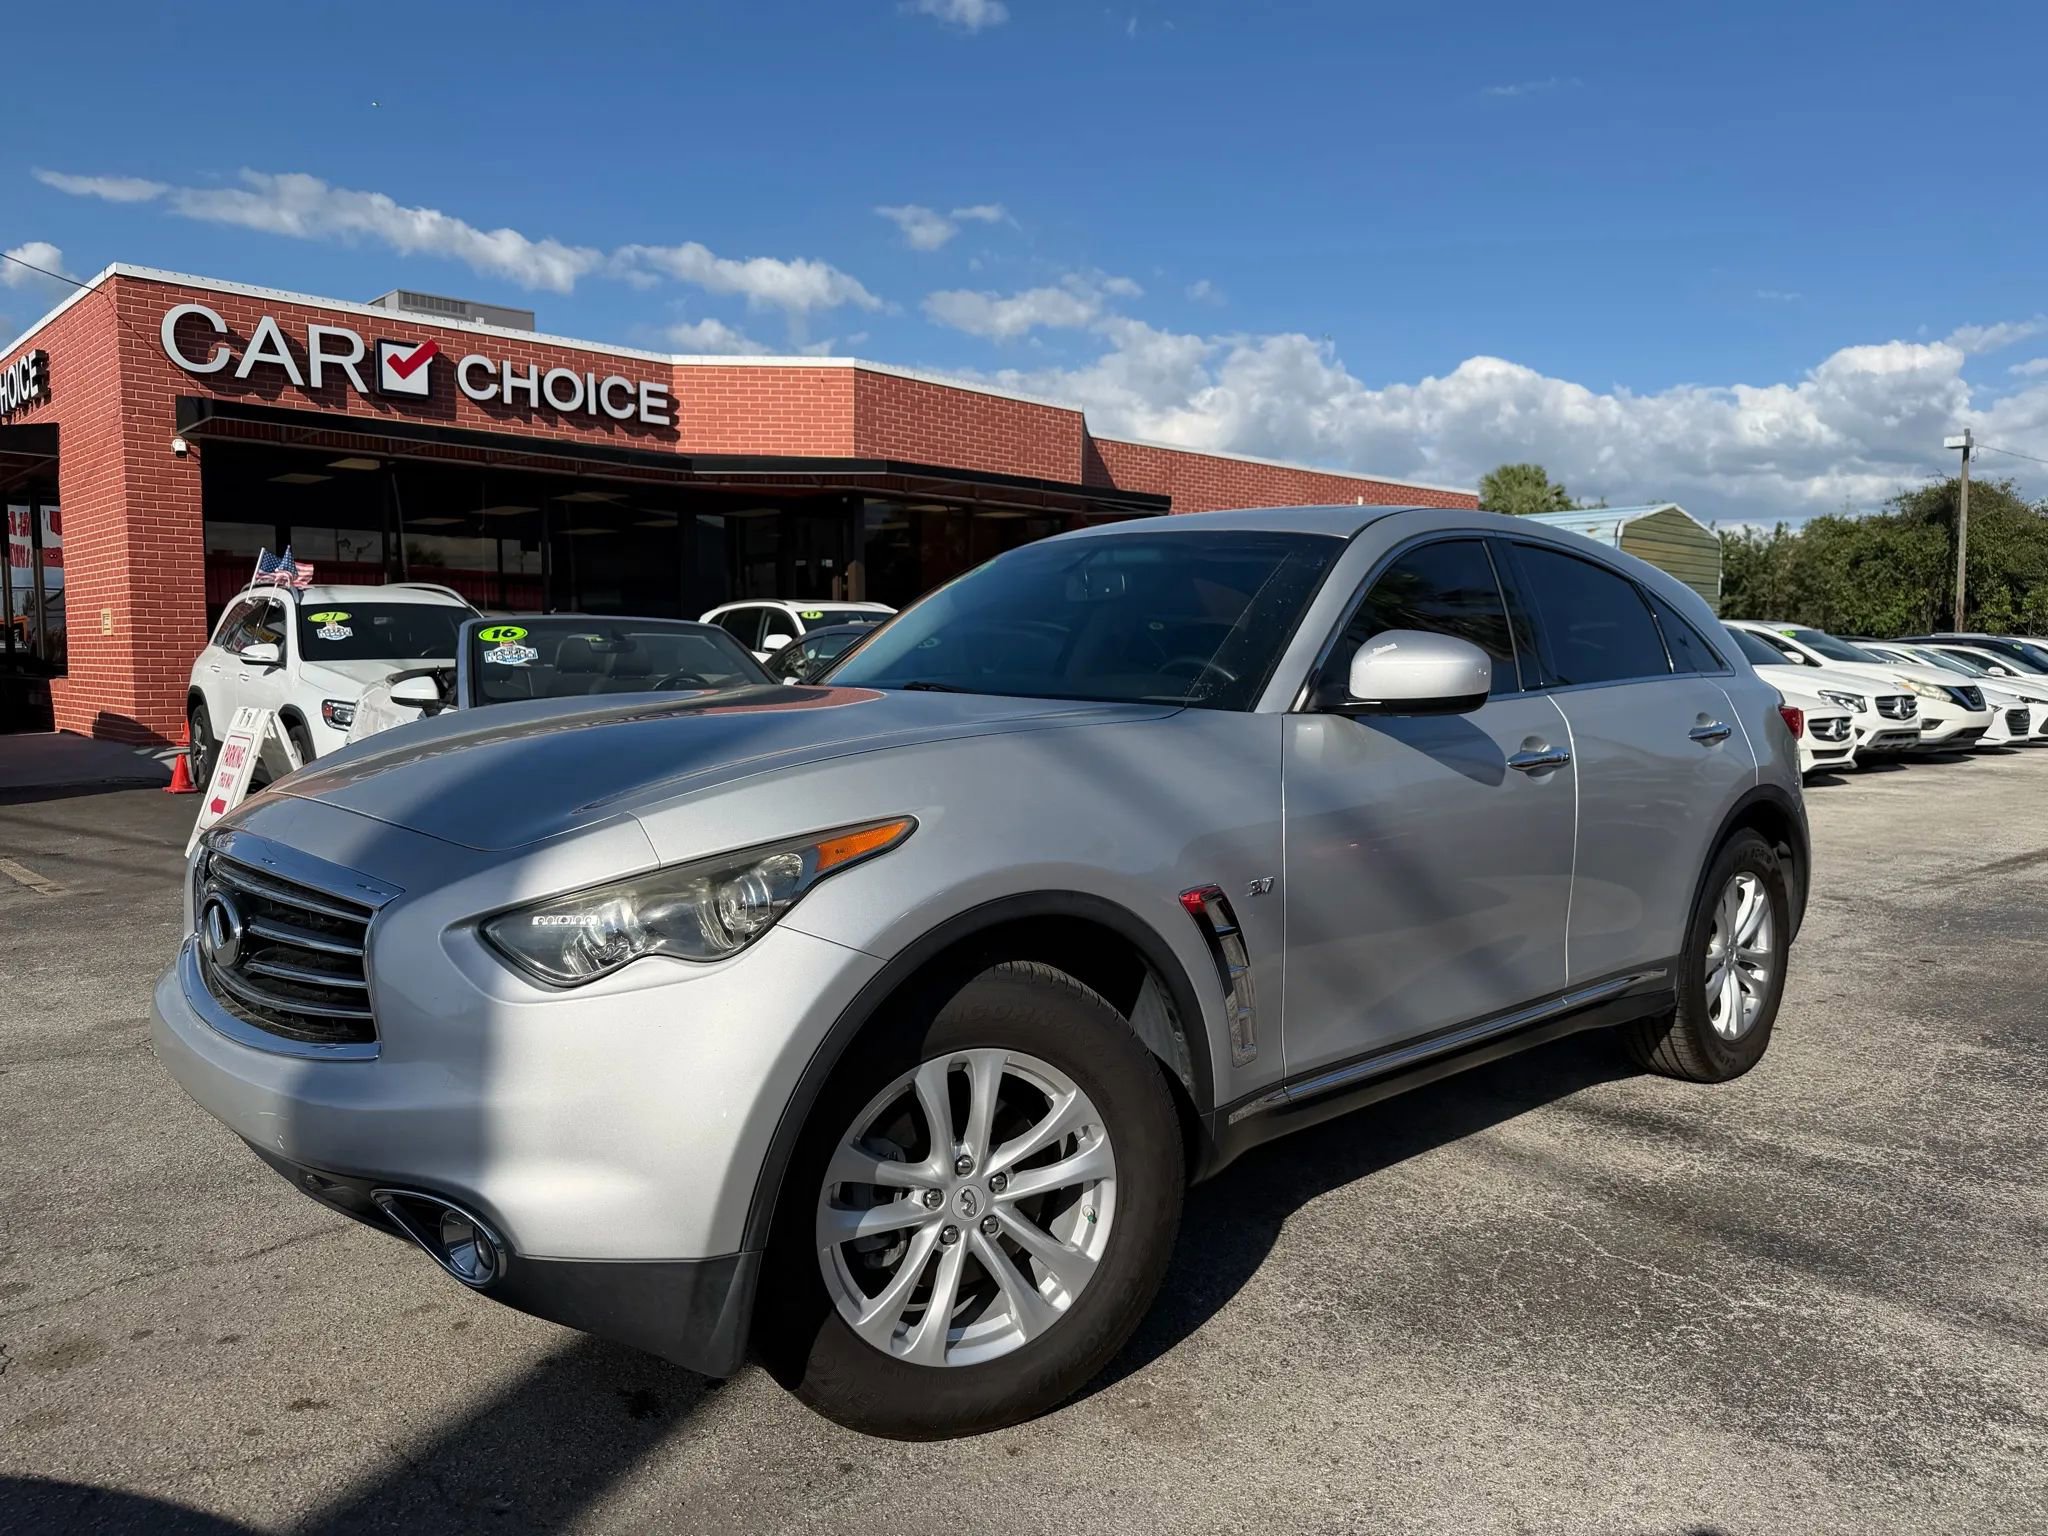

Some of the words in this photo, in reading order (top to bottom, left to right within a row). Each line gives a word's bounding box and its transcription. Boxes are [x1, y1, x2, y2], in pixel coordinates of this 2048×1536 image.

[160, 304, 369, 393] CAR
[457, 354, 671, 425] CHOICE
[492, 628, 517, 639] 16
